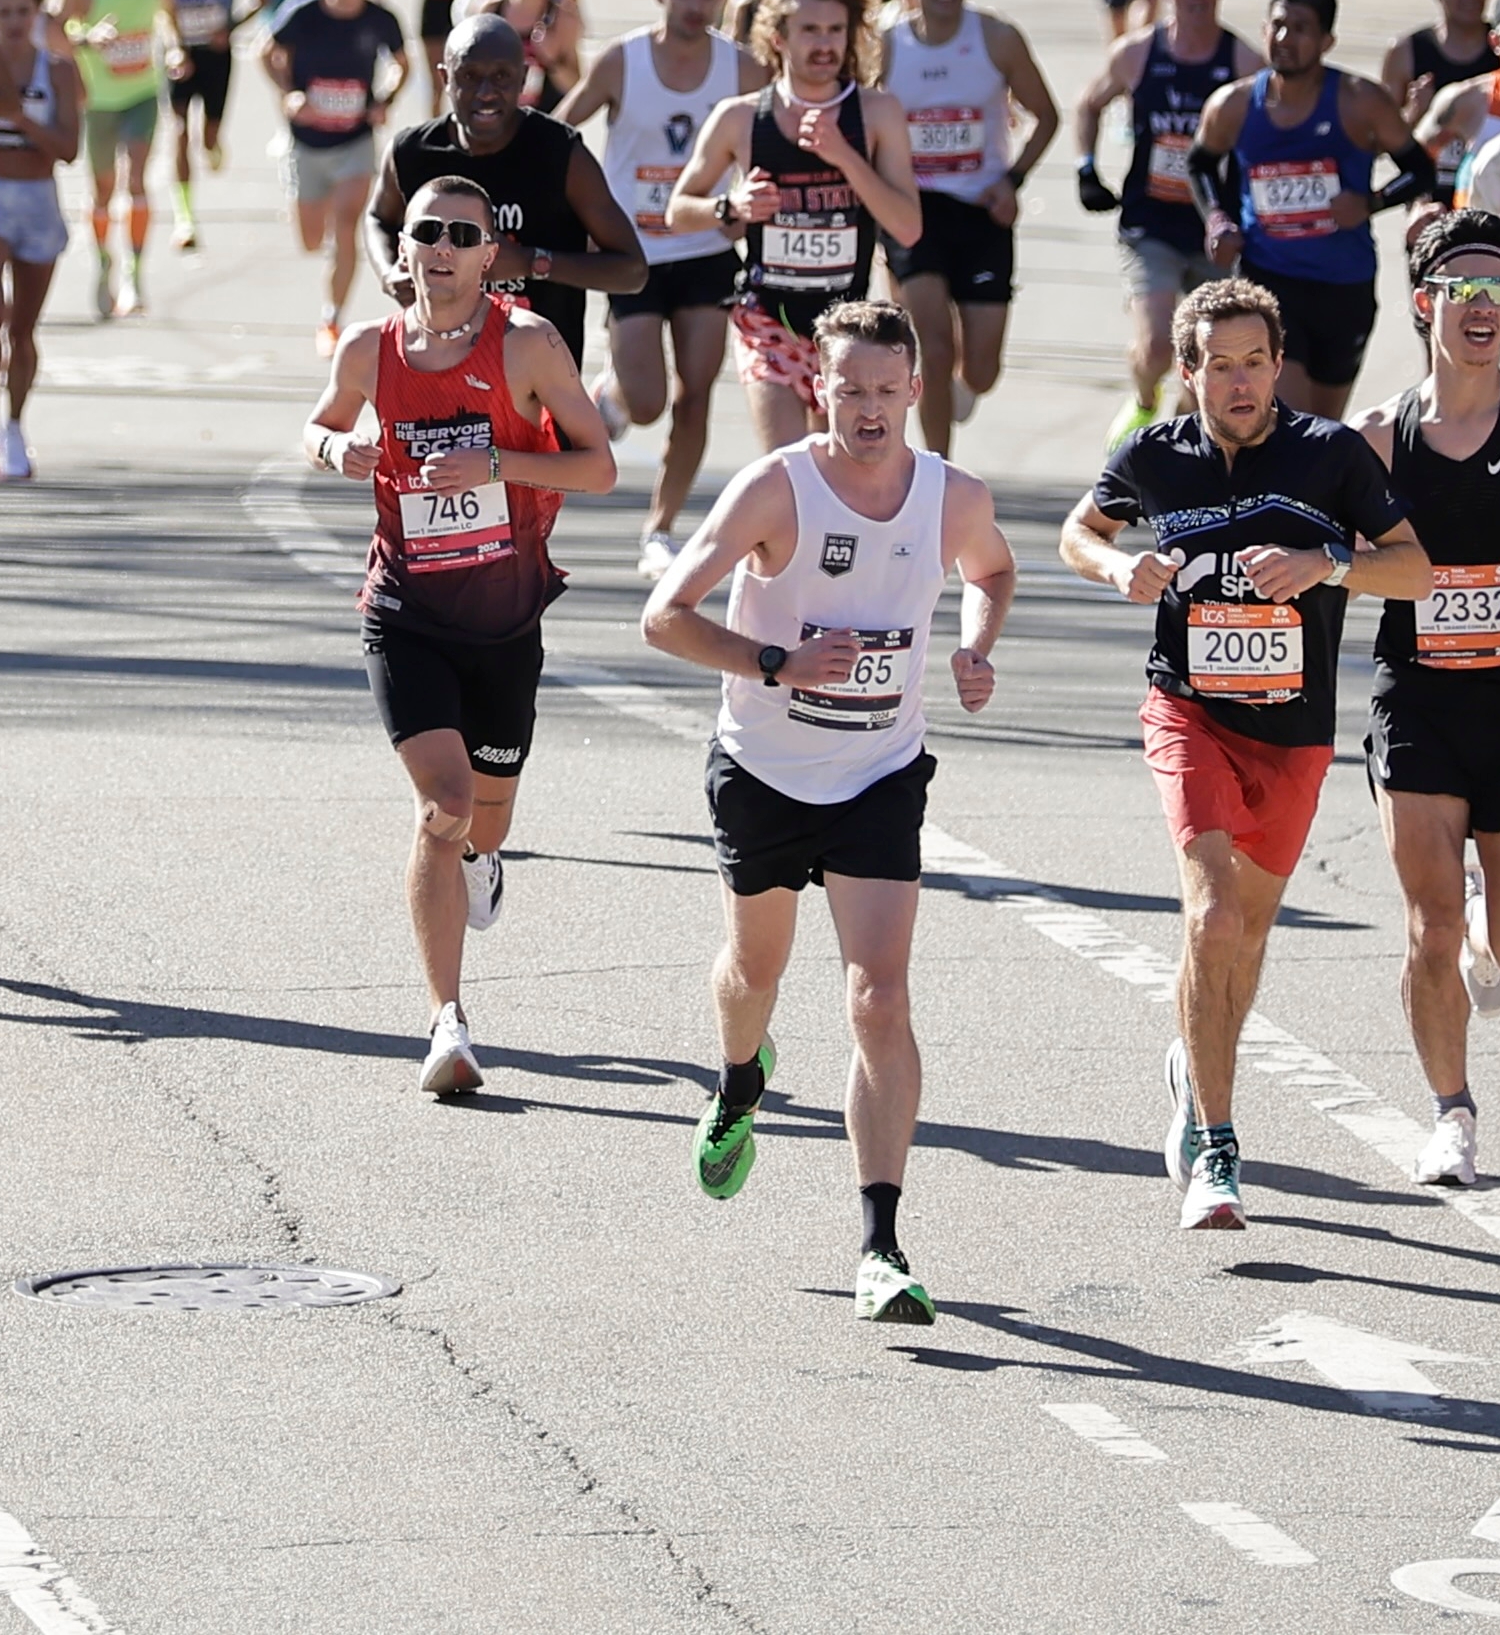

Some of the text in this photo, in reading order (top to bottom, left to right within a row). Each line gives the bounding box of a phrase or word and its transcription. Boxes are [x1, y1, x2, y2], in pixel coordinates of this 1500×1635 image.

[781, 231, 842, 258] 1455
[394, 422, 415, 430] THE
[395, 422, 491, 441] RESERVOIR
[423, 490, 480, 525] 746
[477, 540, 501, 554] 2024
[828, 538, 853, 547] BELIEVE
[1201, 607, 1225, 624] tcs
[1205, 631, 1288, 663] 2005
[854, 654, 894, 685] 65
[861, 686, 868, 694] A
[869, 711, 890, 721] 2024
